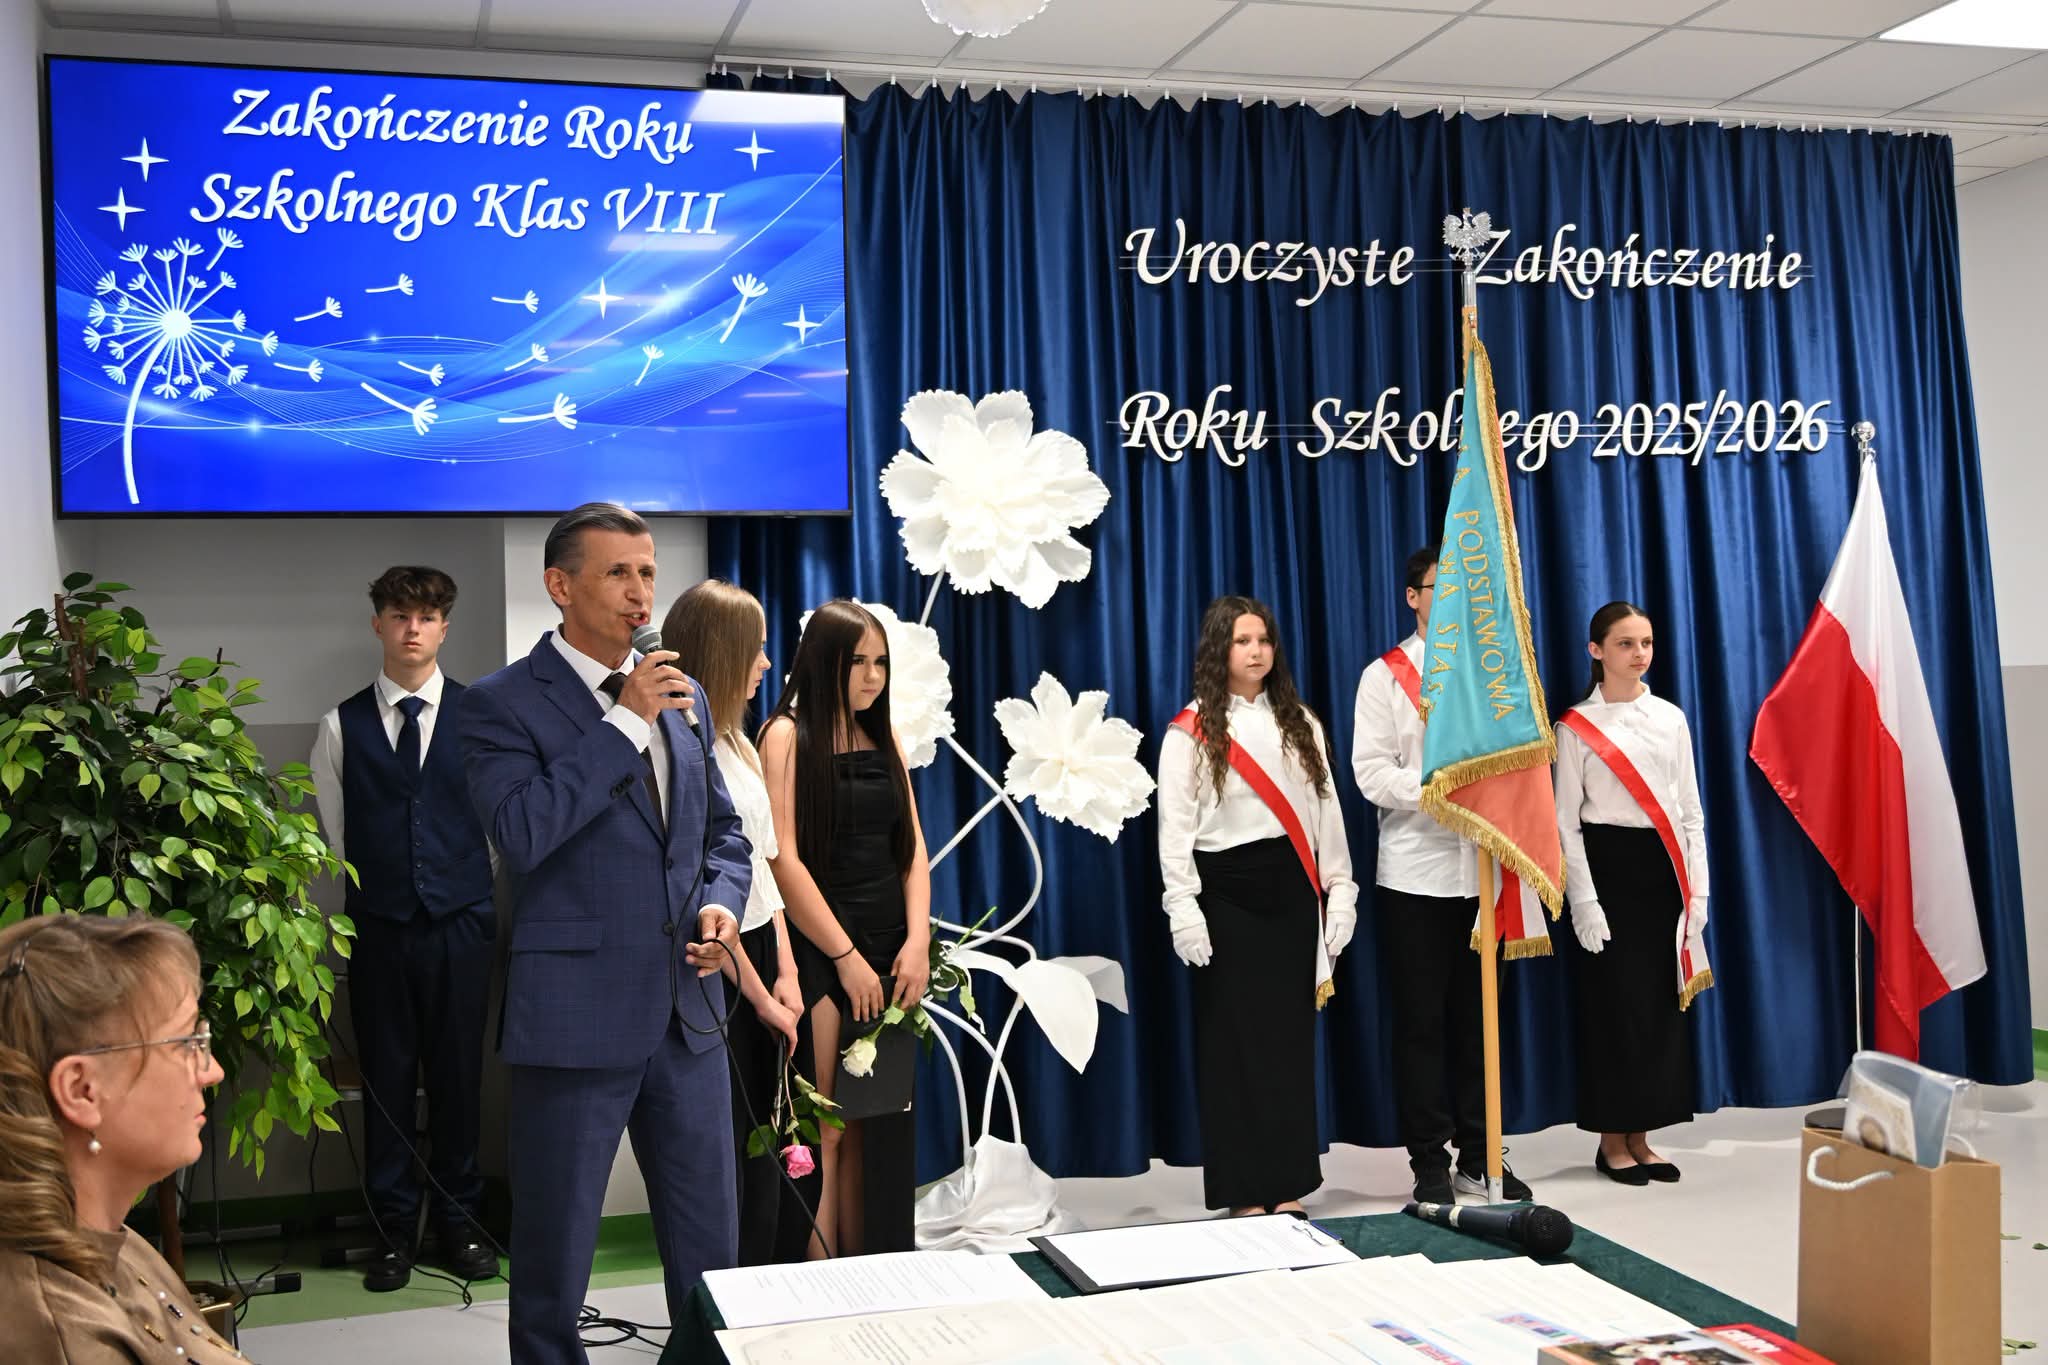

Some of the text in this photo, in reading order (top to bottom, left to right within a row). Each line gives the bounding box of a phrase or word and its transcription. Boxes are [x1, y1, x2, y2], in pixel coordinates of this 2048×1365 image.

[223, 86, 695, 164] Zakończenie Roku
[190, 169, 726, 242] Szkolnego Klas VIII
[1124, 218, 1803, 307] Uroczyste Zakończenie
[1117, 384, 1269, 467] Roku
[1296, 387, 1580, 472] Szkolego
[1591, 390, 1832, 466] 2025/2026
[1453, 510, 1516, 721] PODSTAWOWA
